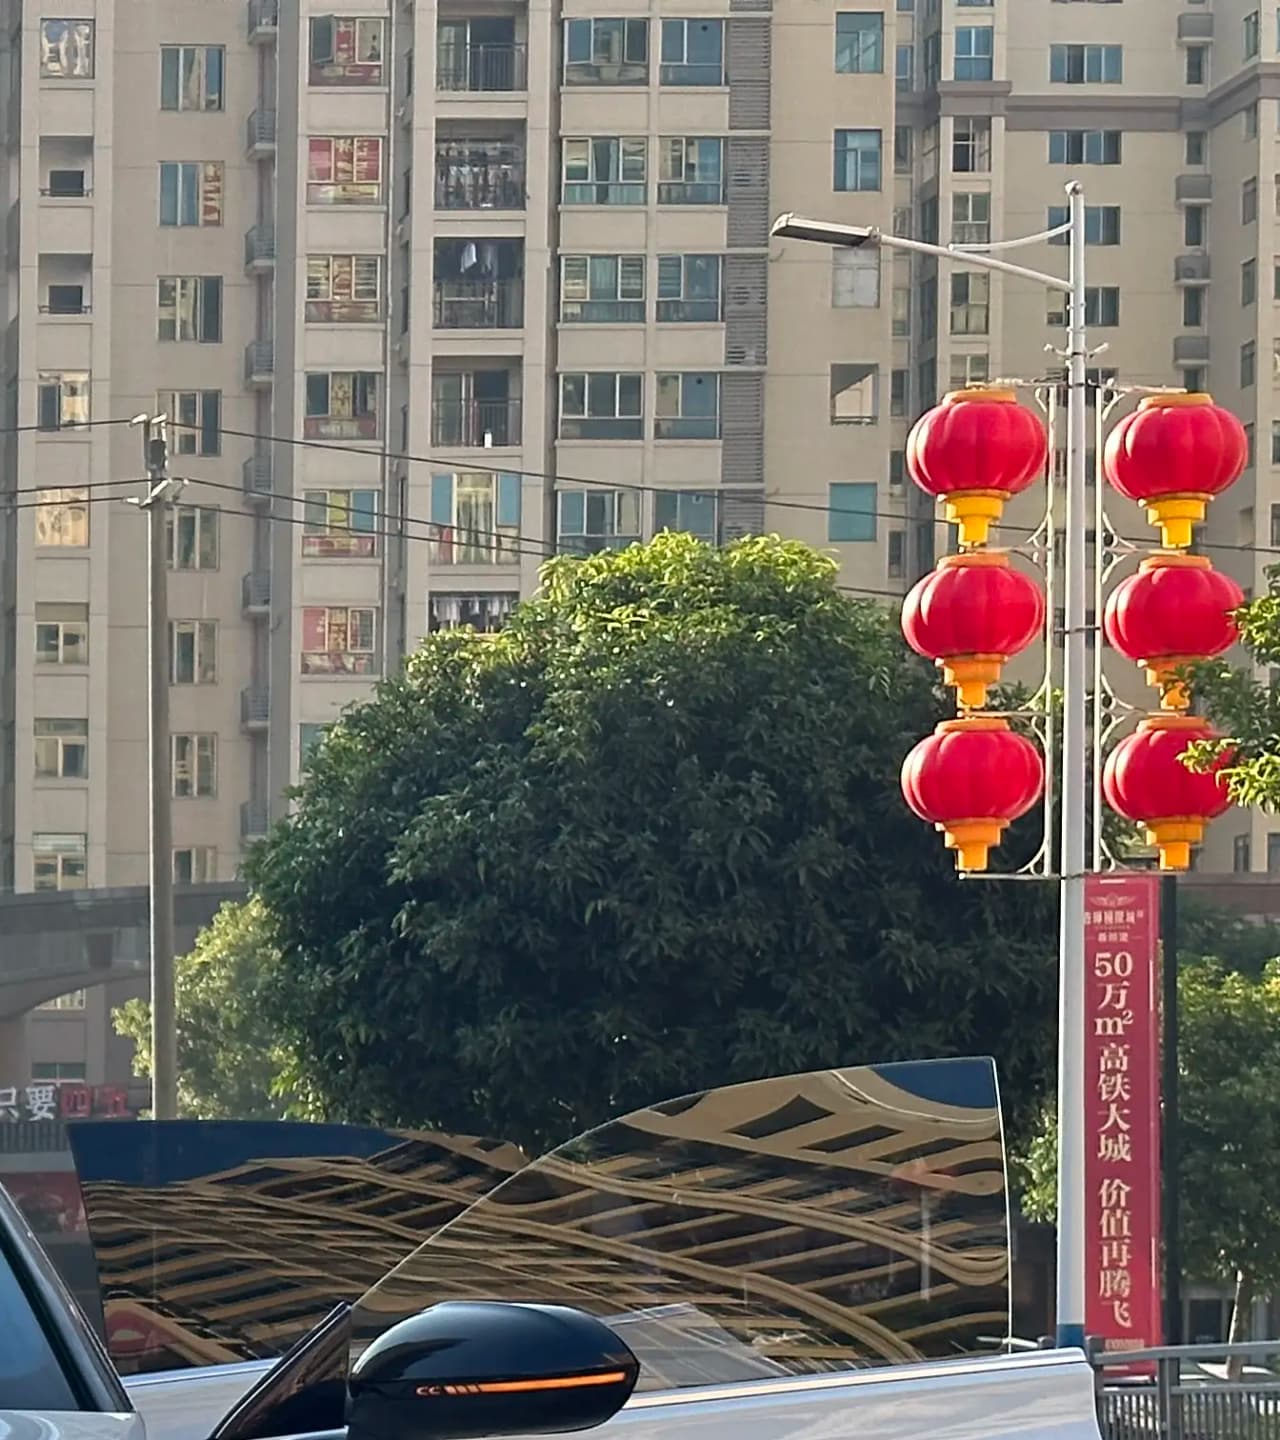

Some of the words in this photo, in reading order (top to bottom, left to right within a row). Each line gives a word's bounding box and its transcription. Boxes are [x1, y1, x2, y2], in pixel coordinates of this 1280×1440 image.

[1099, 1178, 1132, 1328] 价值再腾飞
